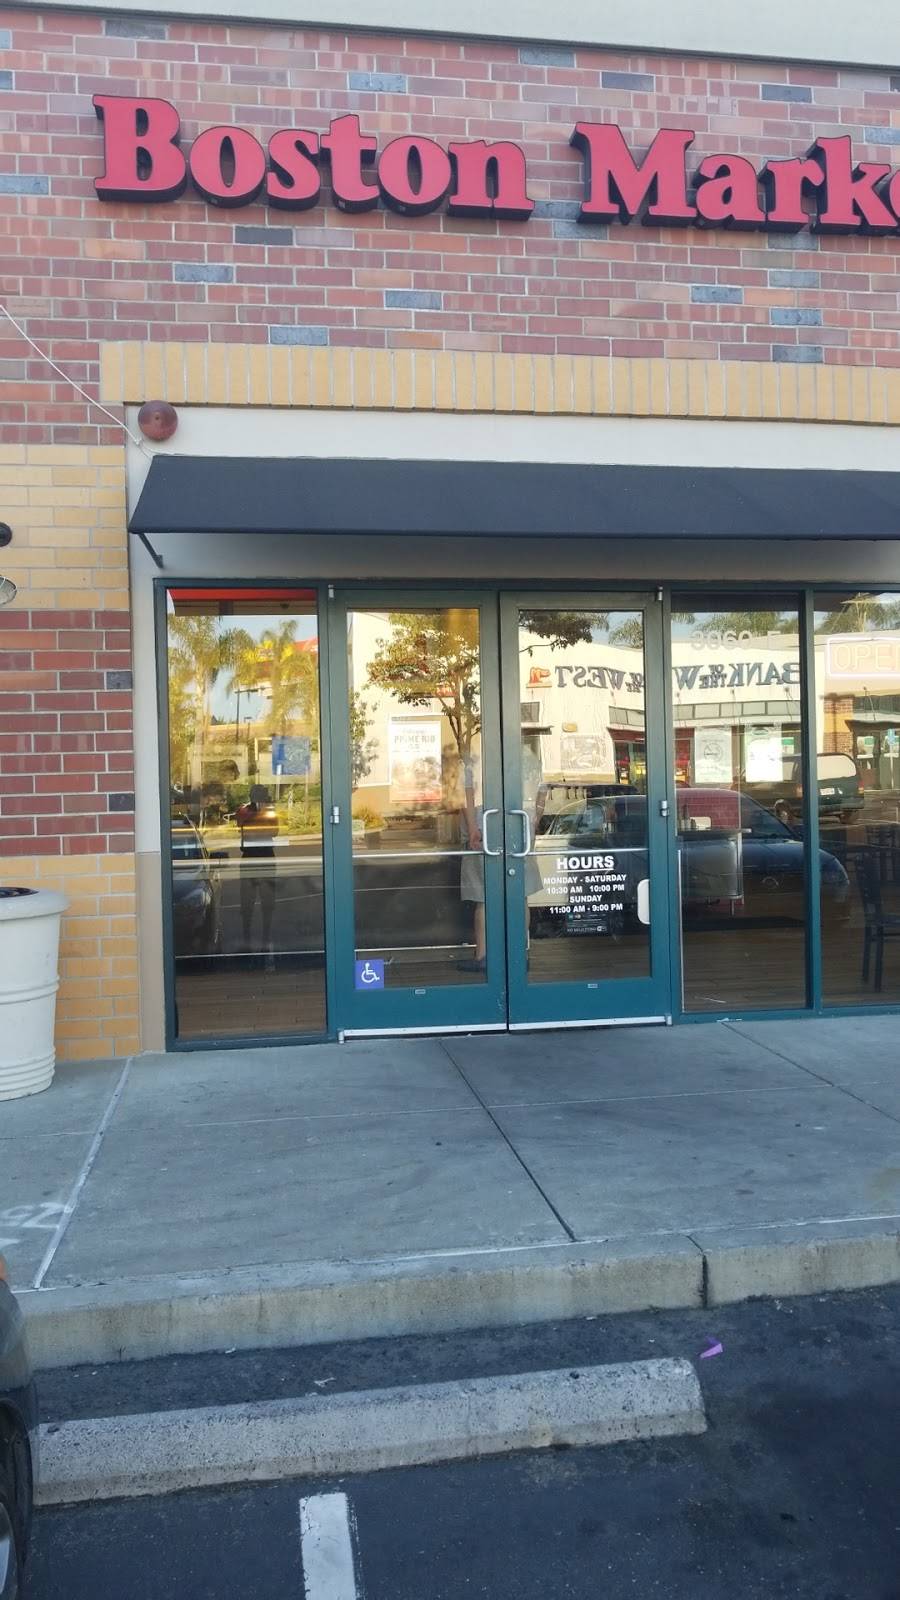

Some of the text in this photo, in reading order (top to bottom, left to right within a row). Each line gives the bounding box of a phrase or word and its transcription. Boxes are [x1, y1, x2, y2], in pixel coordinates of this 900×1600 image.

[93, 93, 900, 232] Boston Mark
[833, 644, 900, 671] OPE
[556, 855, 615, 870] HOURS
[543, 876, 577, 884] MONDAY
[585, 874, 627, 883] SATURDAY
[547, 886, 568, 895] 10:30
[569, 895, 602, 903] SUNDAY
[591, 904, 609, 912] 9:00
